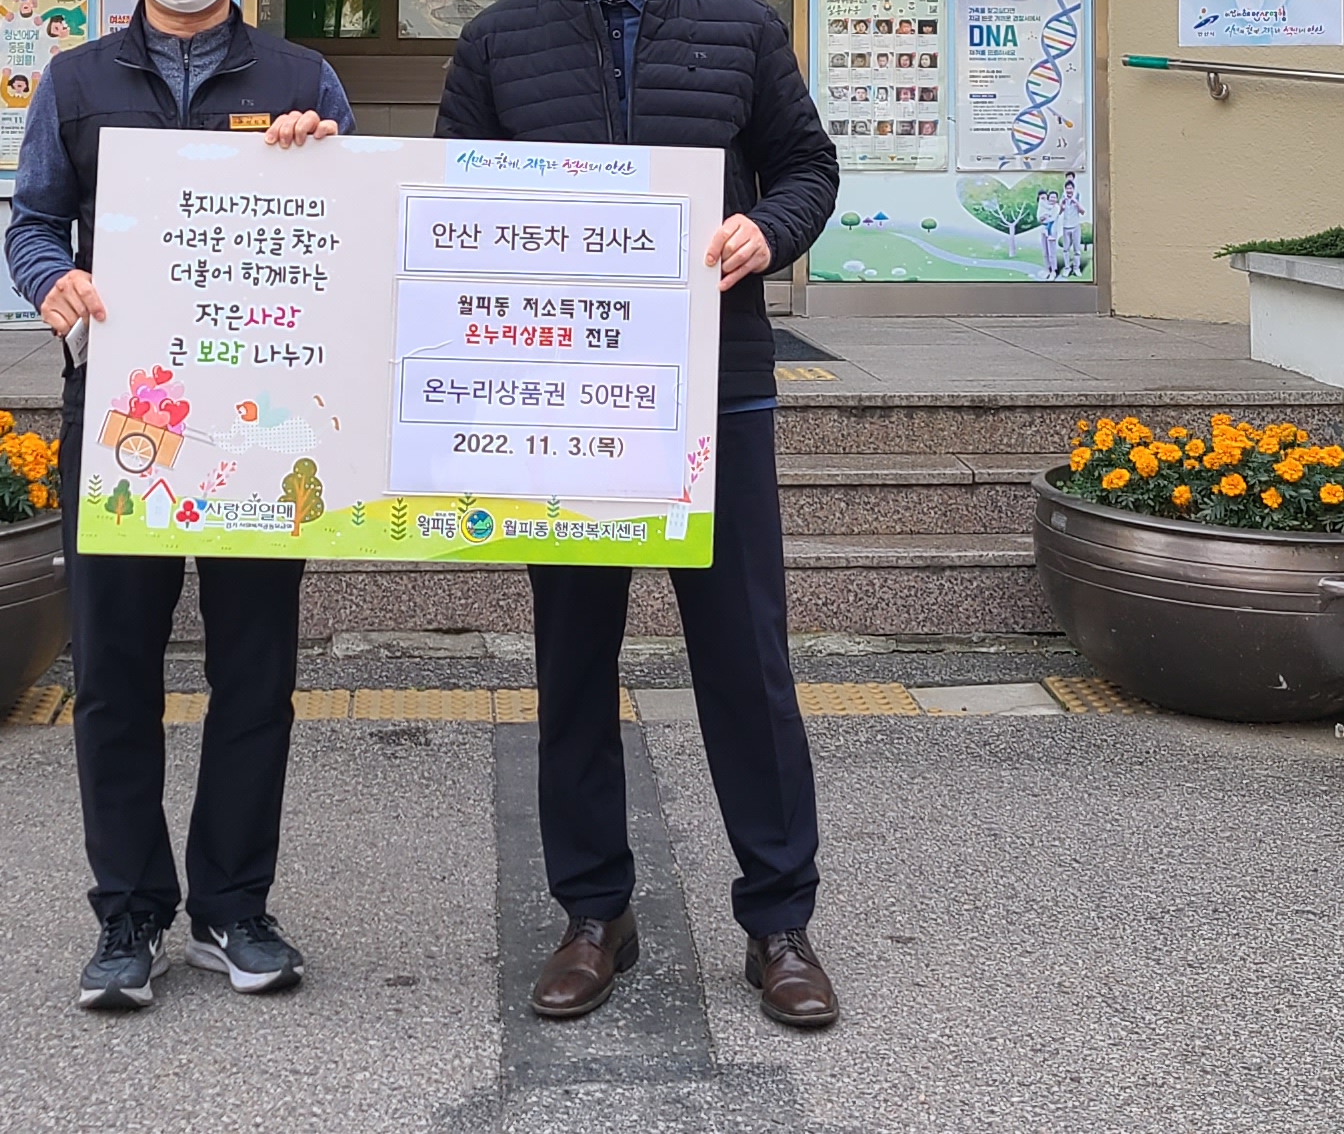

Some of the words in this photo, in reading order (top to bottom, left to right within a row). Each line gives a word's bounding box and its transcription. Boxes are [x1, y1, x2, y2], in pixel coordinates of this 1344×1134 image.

[3, 29, 40, 41] 청년에게
[969, 24, 1019, 47] DNA
[604, 160, 638, 176] 안산
[179, 190, 325, 218] 복지사각지대의
[162, 226, 226, 253] 어려운
[233, 227, 286, 256] 이웃을
[291, 228, 341, 255] 찾아
[431, 221, 483, 249] 안산
[494, 223, 570, 253] 자동차
[582, 226, 656, 254] 검사소
[170, 258, 232, 288] 더불어
[241, 261, 328, 291] 함께하는
[457, 294, 511, 317] 월피동
[522, 297, 632, 322] 저소득가정에
[464, 323, 574, 348] 온누리상품권
[585, 327, 622, 349] 전달
[169, 337, 188, 366] 큰
[197, 340, 246, 365] 보람
[253, 342, 324, 367] 나누기
[422, 377, 567, 407] 온누리상품권
[579, 383, 657, 410] 50만원
[453, 433, 514, 455] 2022.
[525, 435, 558, 456] 11.
[568, 436, 625, 459] 3.(목)
[205, 502, 294, 521] 사랑의열매
[417, 514, 457, 539] 월피동
[503, 519, 549, 538] 월피동
[554, 520, 647, 541] 행정복지센터
